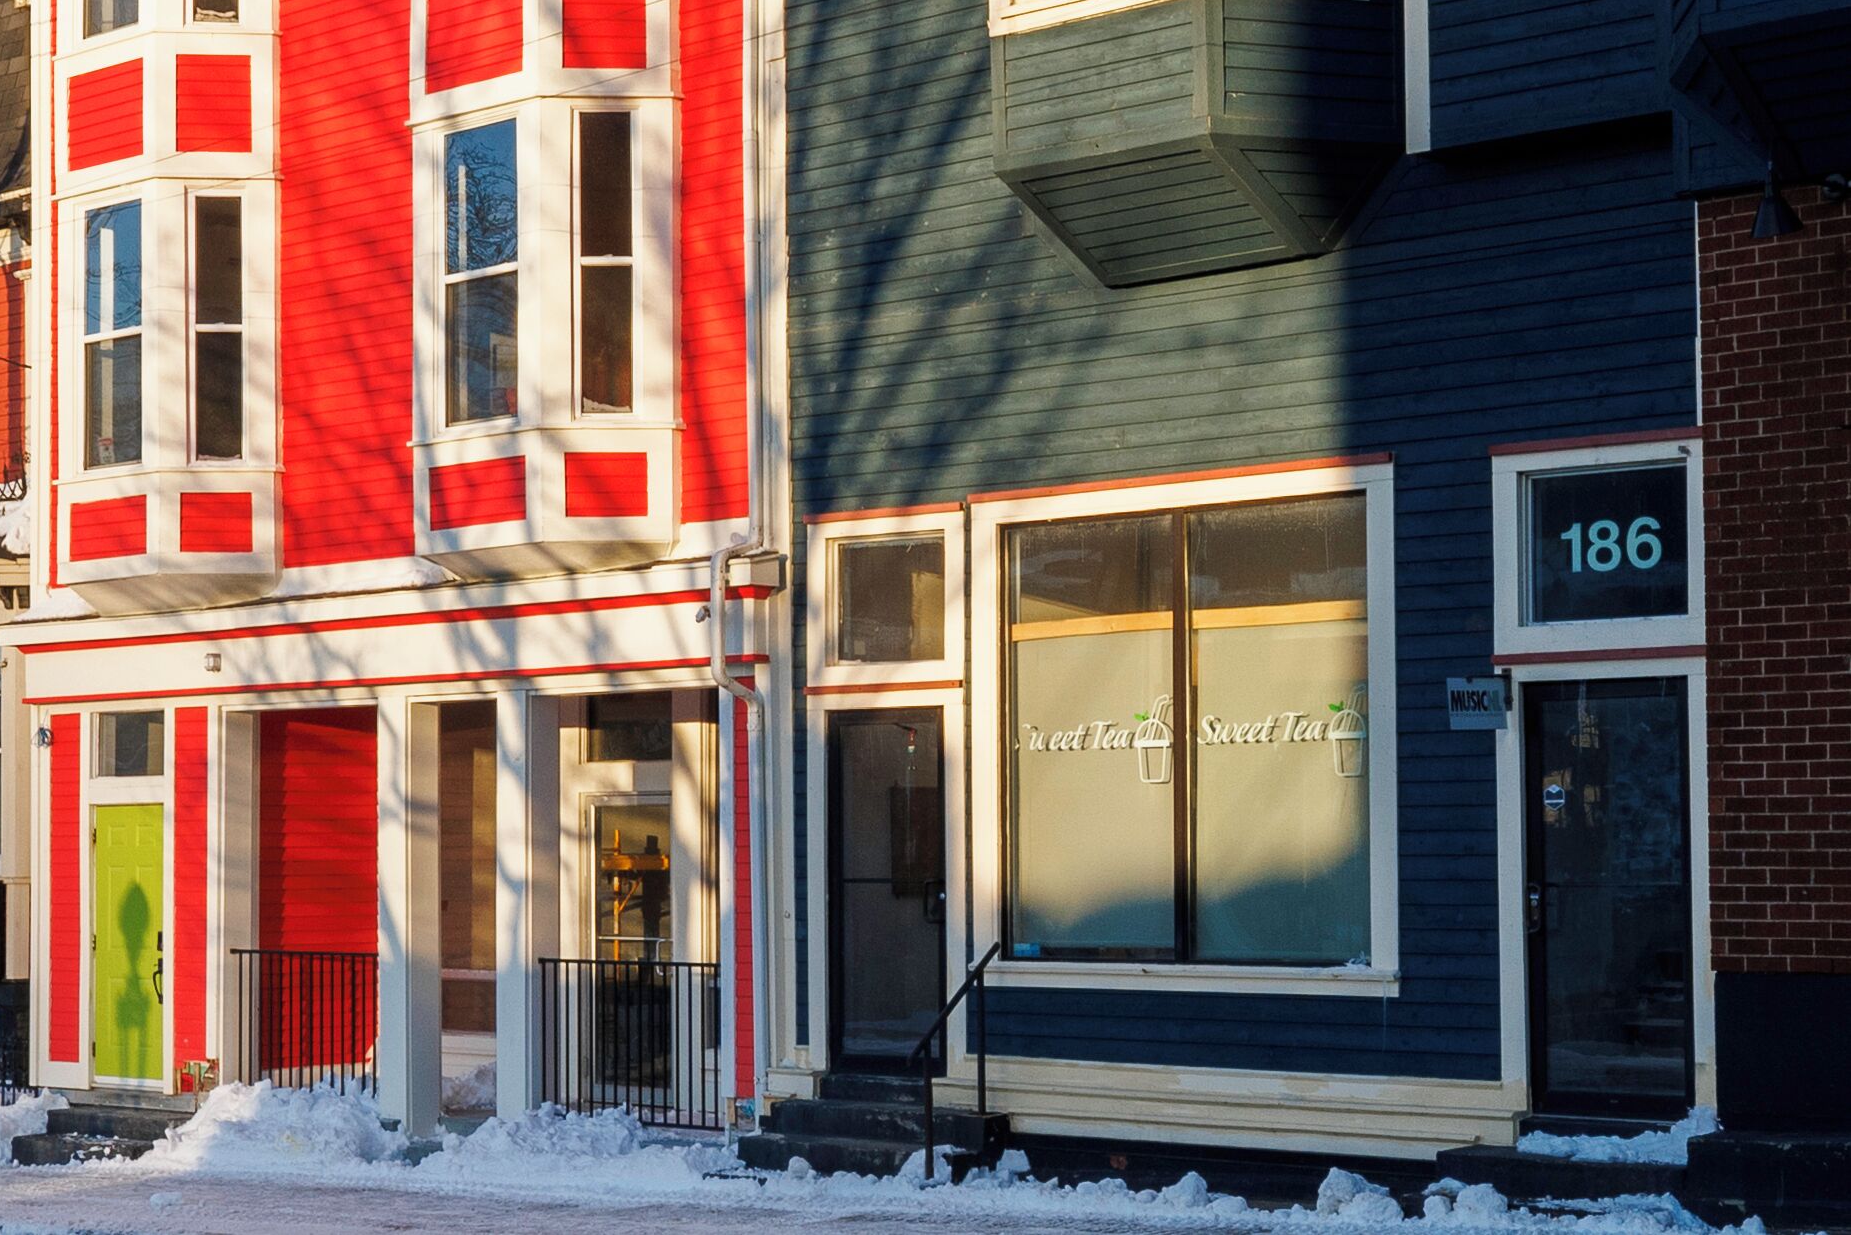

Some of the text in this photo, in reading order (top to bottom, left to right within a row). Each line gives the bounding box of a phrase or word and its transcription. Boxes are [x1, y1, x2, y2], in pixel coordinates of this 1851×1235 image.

[1561, 517, 1663, 573] 186
[1015, 720, 1135, 751] weet Tea
[1197, 710, 1330, 745] Sweet Tea
